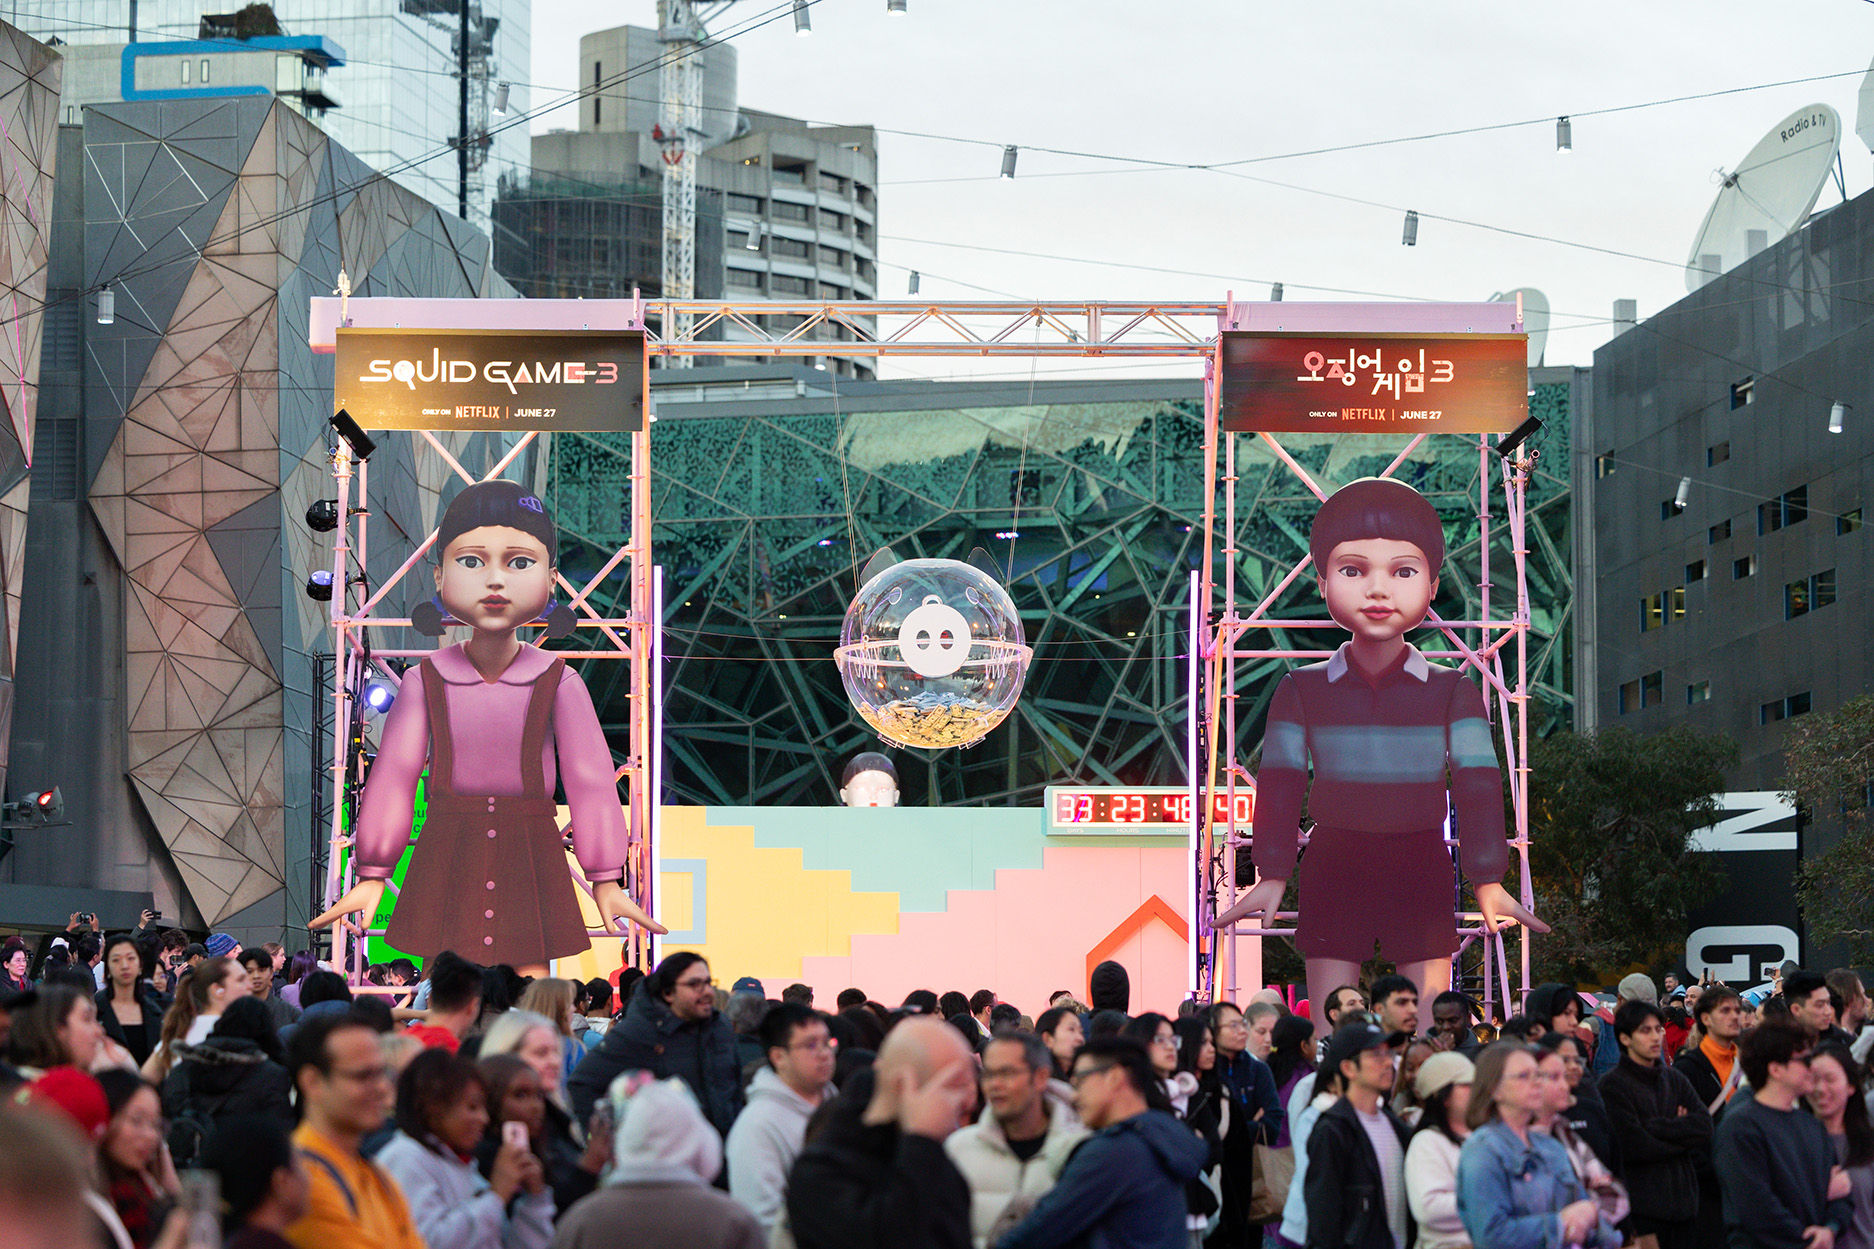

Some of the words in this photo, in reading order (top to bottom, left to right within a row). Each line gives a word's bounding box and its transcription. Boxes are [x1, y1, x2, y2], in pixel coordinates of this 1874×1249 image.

[1780, 118, 1809, 143] Radio
[1811, 114, 1817, 126] &
[1819, 113, 1827, 127] TV
[359, 348, 477, 390] SQUID
[1297, 348, 1381, 386] 오징어
[1371, 348, 1424, 400] 게임
[1430, 359, 1454, 383] 3
[421, 408, 440, 416] ONLY
[440, 408, 451, 416] ON
[455, 405, 500, 419] NETFLIX
[514, 408, 542, 418] JUNE
[543, 408, 556, 418] 27
[1341, 408, 1386, 421] NETFLIX
[1400, 411, 1428, 420] JUNE
[1429, 411, 1442, 420] 27
